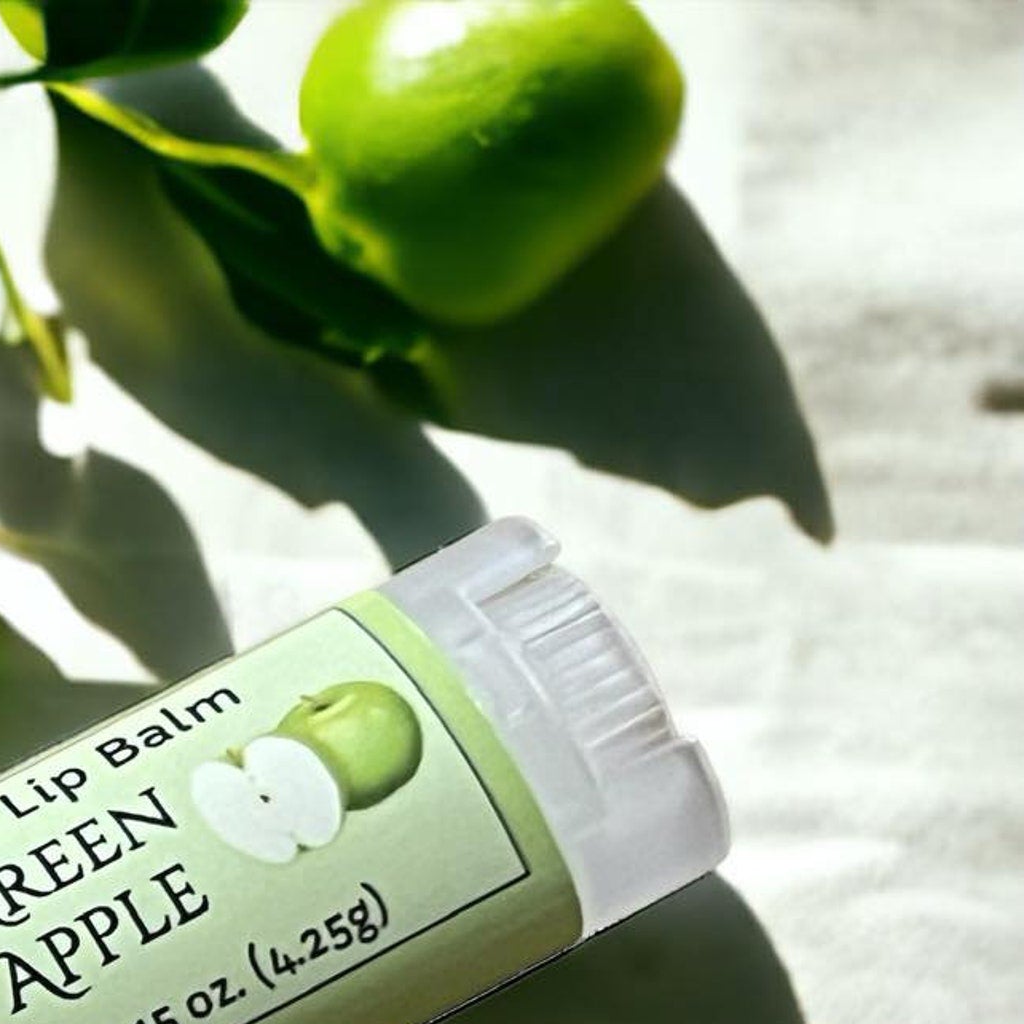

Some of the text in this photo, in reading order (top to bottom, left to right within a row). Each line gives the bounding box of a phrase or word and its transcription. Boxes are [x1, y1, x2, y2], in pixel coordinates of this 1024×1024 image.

[94, 687, 242, 769] Balm
[185, 977, 247, 1020] oz.
[247, 881, 389, 991] (4.25g)
